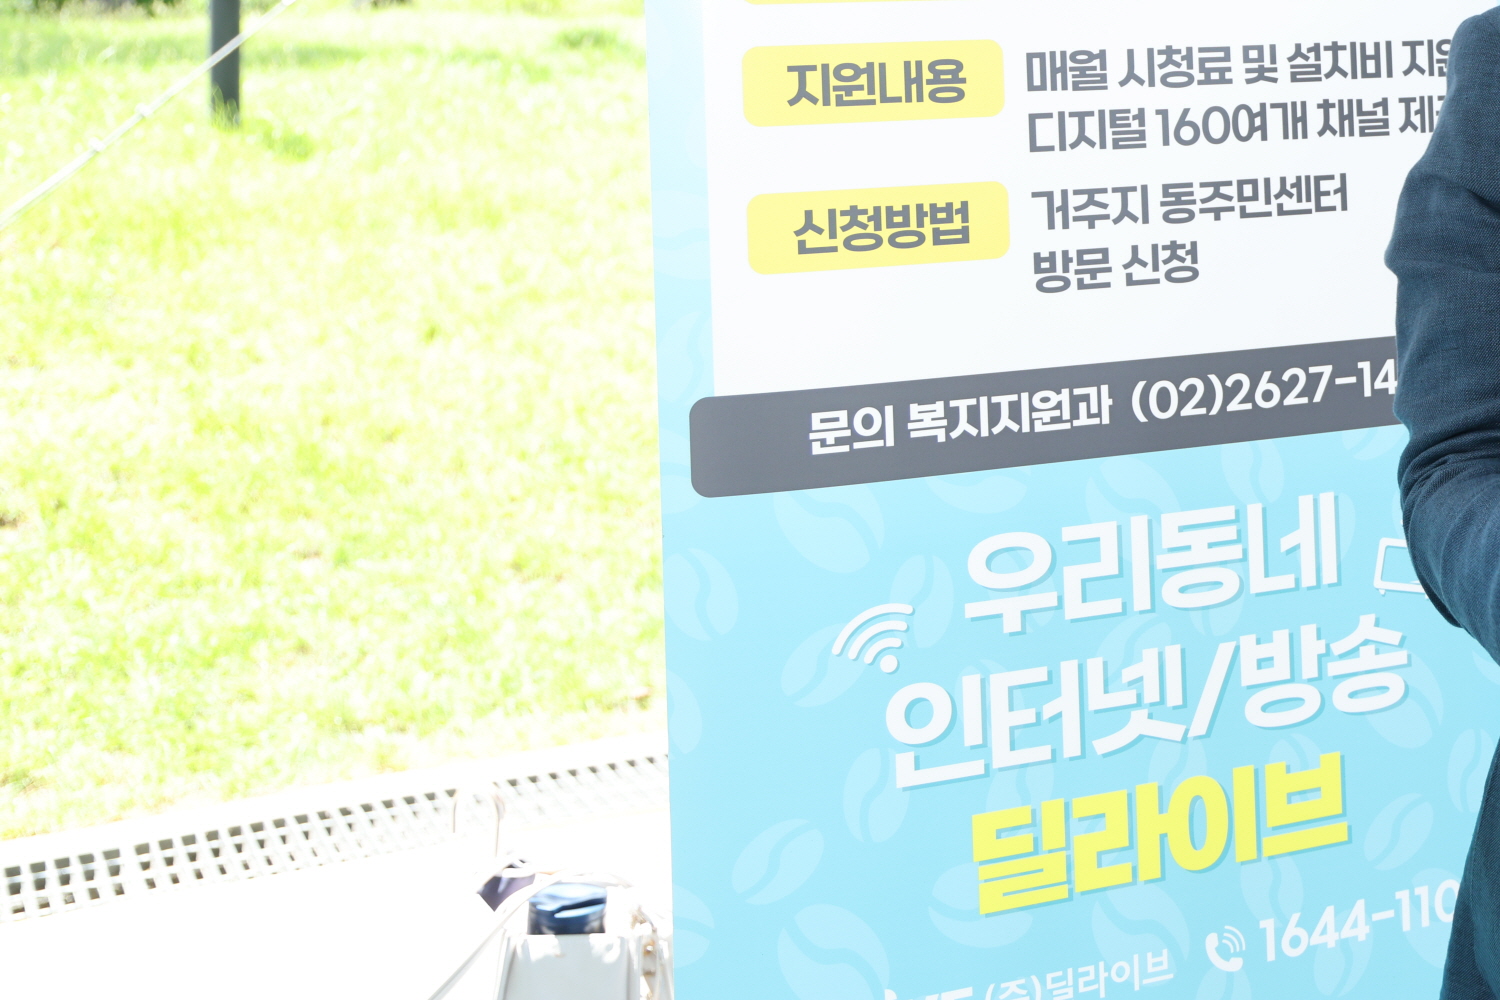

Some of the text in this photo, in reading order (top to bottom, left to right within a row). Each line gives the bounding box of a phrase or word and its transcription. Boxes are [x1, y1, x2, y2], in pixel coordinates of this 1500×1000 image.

[786, 57, 967, 109] 지원내용
[1025, 48, 1109, 93] 매월
[1117, 45, 1233, 89] 시청료
[1241, 43, 1277, 86] 및
[1286, 40, 1394, 84] 설치비
[1027, 95, 1446, 154] 디지털 160여개 채널 제
[793, 200, 971, 256] 신청방법
[1031, 172, 1348, 232] 거주지 동주민센터
[1032, 239, 1201, 295] 방문 신청
[808, 405, 895, 456] 문의
[906, 384, 1113, 444] 복지지원과
[964, 491, 1341, 636] 우리동네
[886, 613, 1408, 789] 인터넷/방송
[970, 750, 1350, 916] 딜라이브
